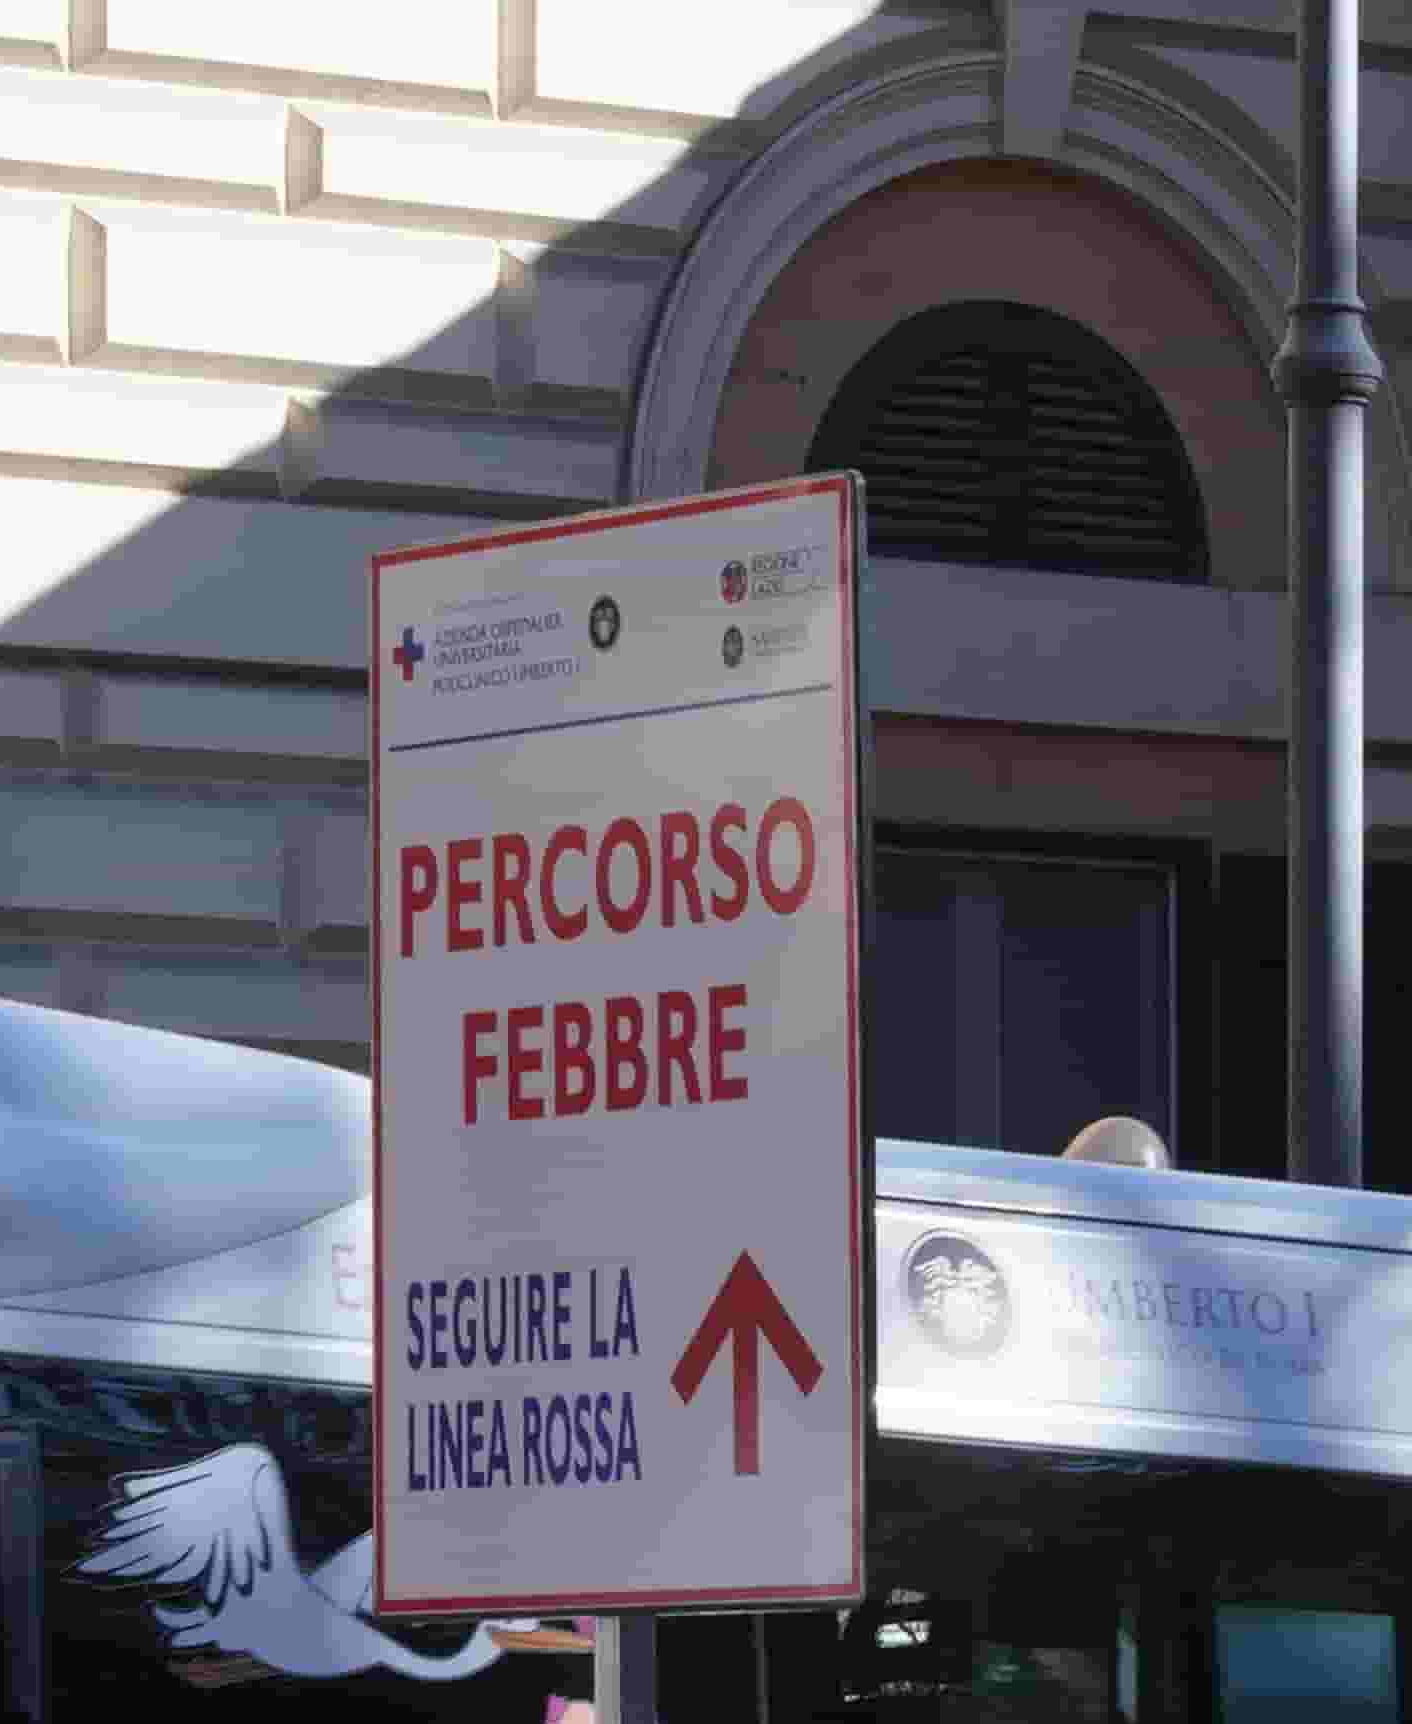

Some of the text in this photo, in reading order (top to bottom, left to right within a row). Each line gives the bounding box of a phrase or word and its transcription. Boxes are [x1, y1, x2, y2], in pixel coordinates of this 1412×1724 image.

[399, 796, 816, 959] PERCORSO
[463, 983, 749, 1125] FEBBRE
[407, 1267, 639, 1371] SEGUIRE LA
[407, 1391, 642, 1492] LINEA ROSSA
